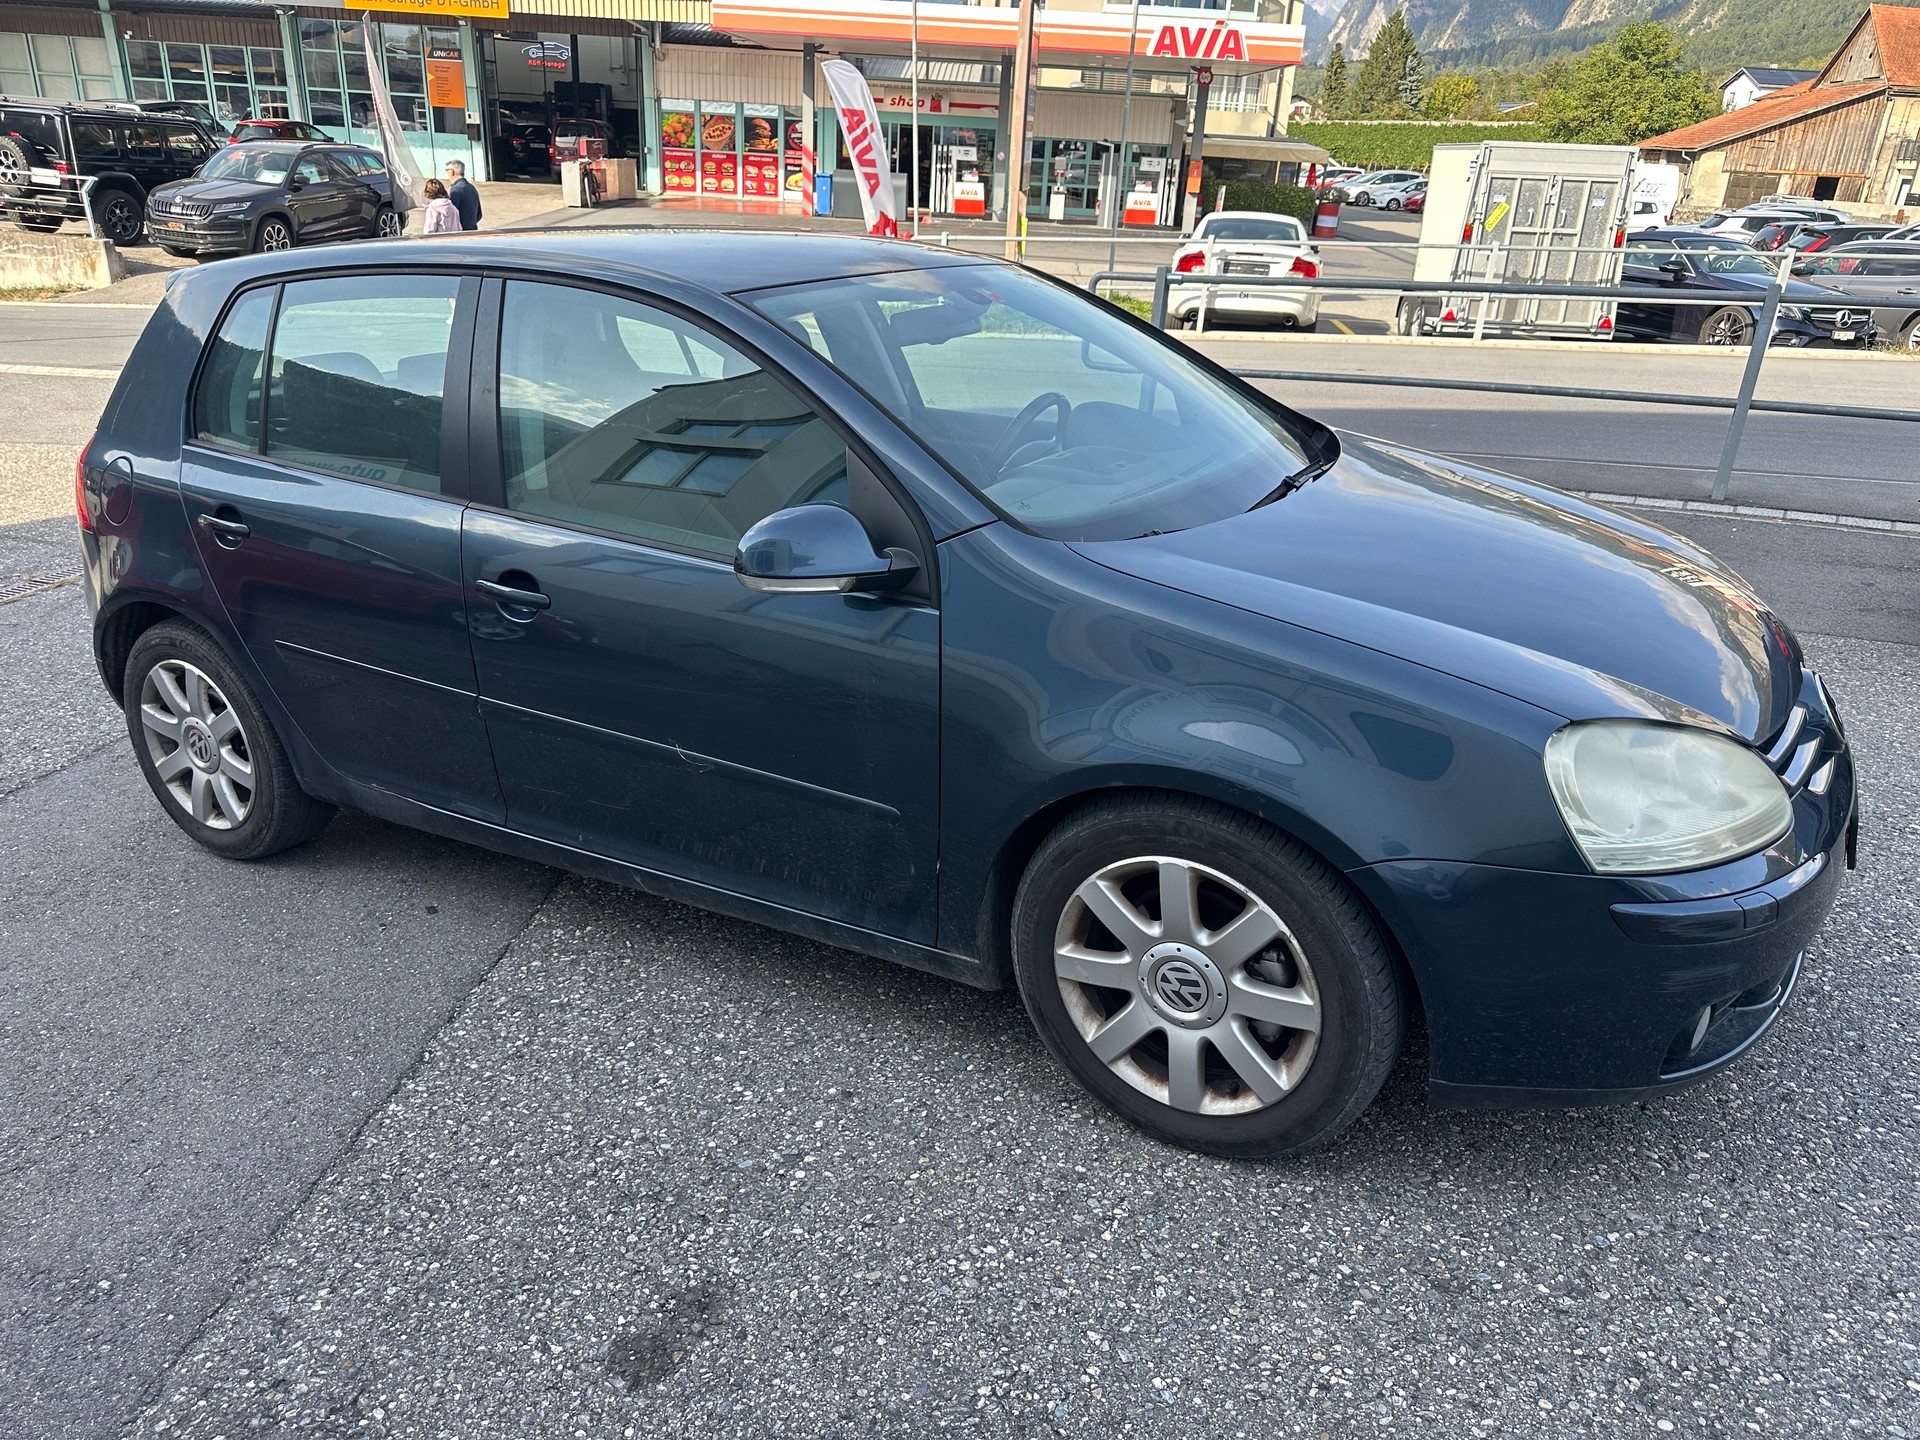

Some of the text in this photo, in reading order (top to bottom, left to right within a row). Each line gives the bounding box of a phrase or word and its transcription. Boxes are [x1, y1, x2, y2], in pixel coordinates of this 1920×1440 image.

[437, 0, 499, 9] -GmbH
[1152, 20, 1244, 60] AVIA
[889, 95, 925, 108] shop
[842, 107, 881, 199] AVIA
[1133, 199, 1151, 207] AVIA
